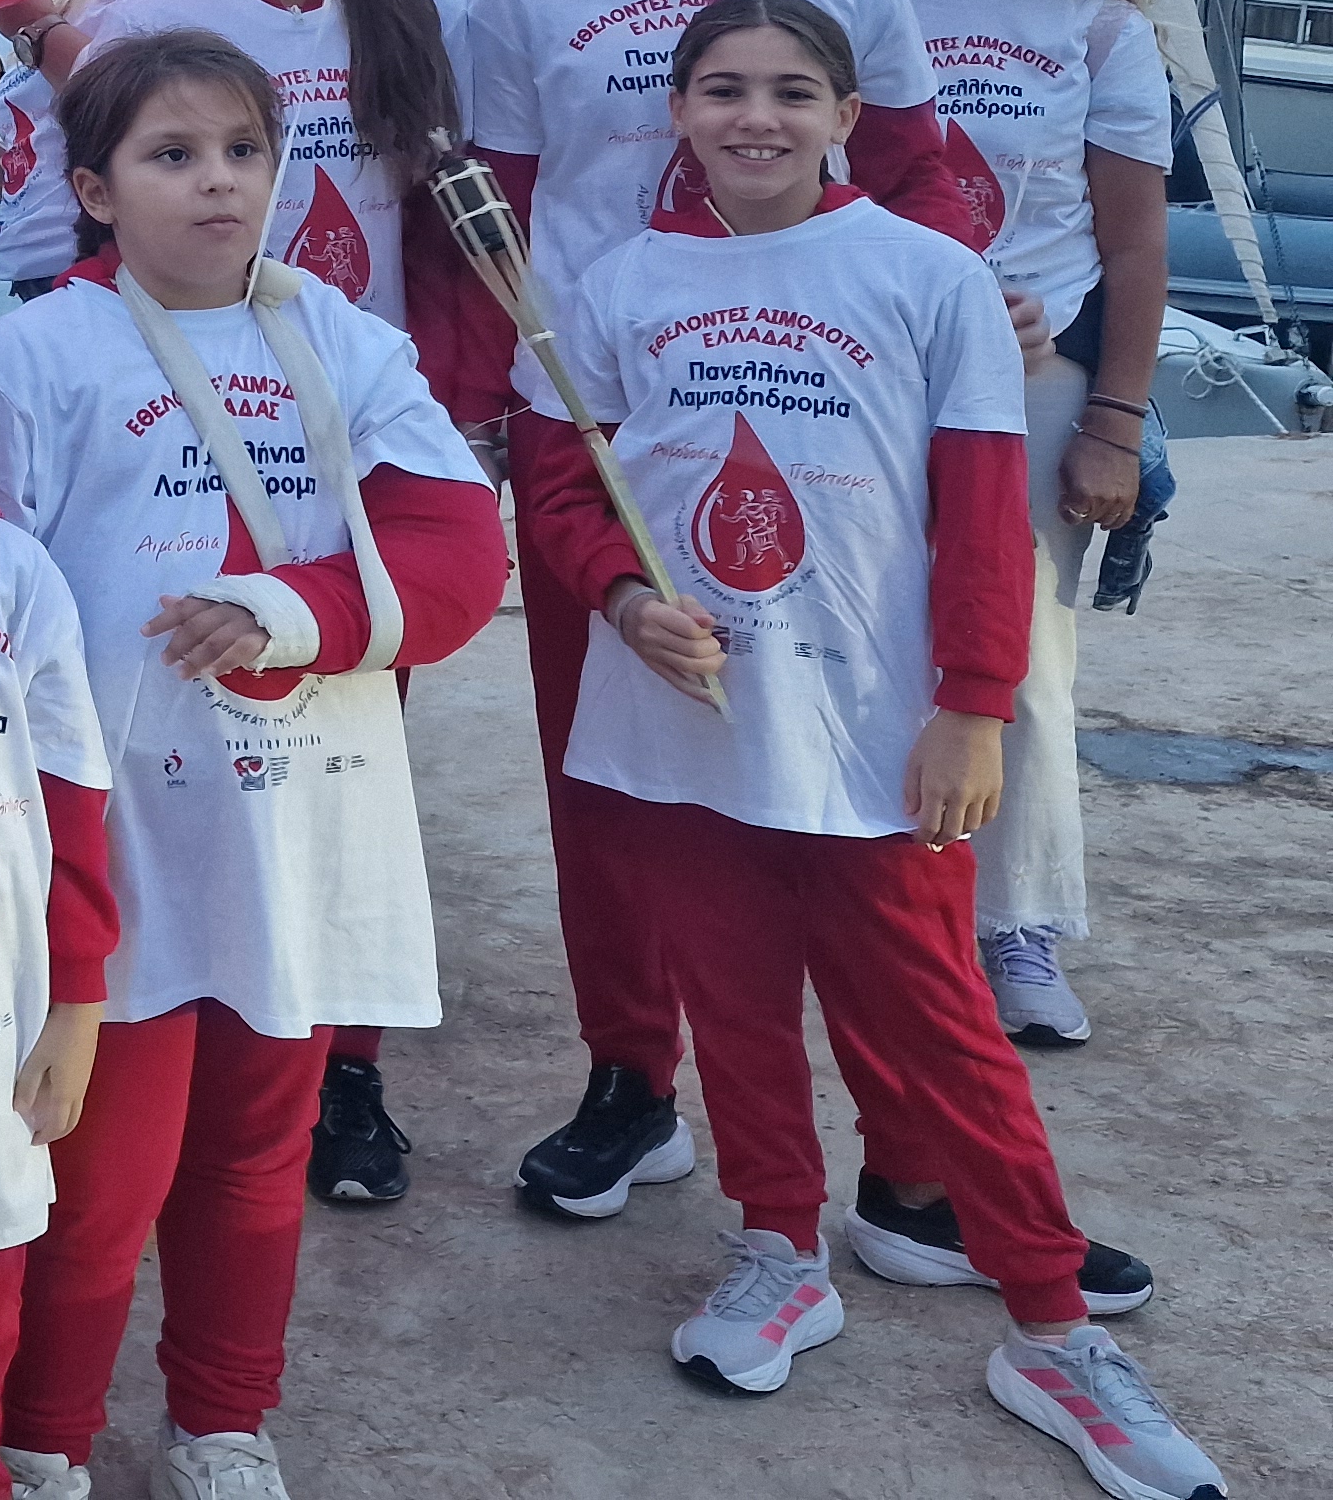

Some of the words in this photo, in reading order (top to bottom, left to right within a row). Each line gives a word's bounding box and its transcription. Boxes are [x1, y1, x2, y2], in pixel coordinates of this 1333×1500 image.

[629, 12, 690, 36] ΕΛΛΑ
[932, 53, 1007, 71] ΛΛΑΔΑΣ
[964, 35, 1065, 79] ΑΙΜΟΔΟΤΕΣ
[938, 78, 1023, 97] νελλήνια
[937, 98, 1045, 120] αδηδρομία
[648, 306, 749, 359] ΕΘΕΛΟΝΤΕΣ
[755, 307, 875, 369] ΑΙΜΟΔΟΤΕΣ
[702, 327, 806, 352] ΕΛΛΑΔΑΣ
[227, 373, 296, 400] ΑΙΜΟΔ
[689, 361, 825, 388] Πανελλήνια
[223, 398, 281, 421] ΑΔΑΣ
[668, 385, 851, 418] Λαμπαδηδρομία
